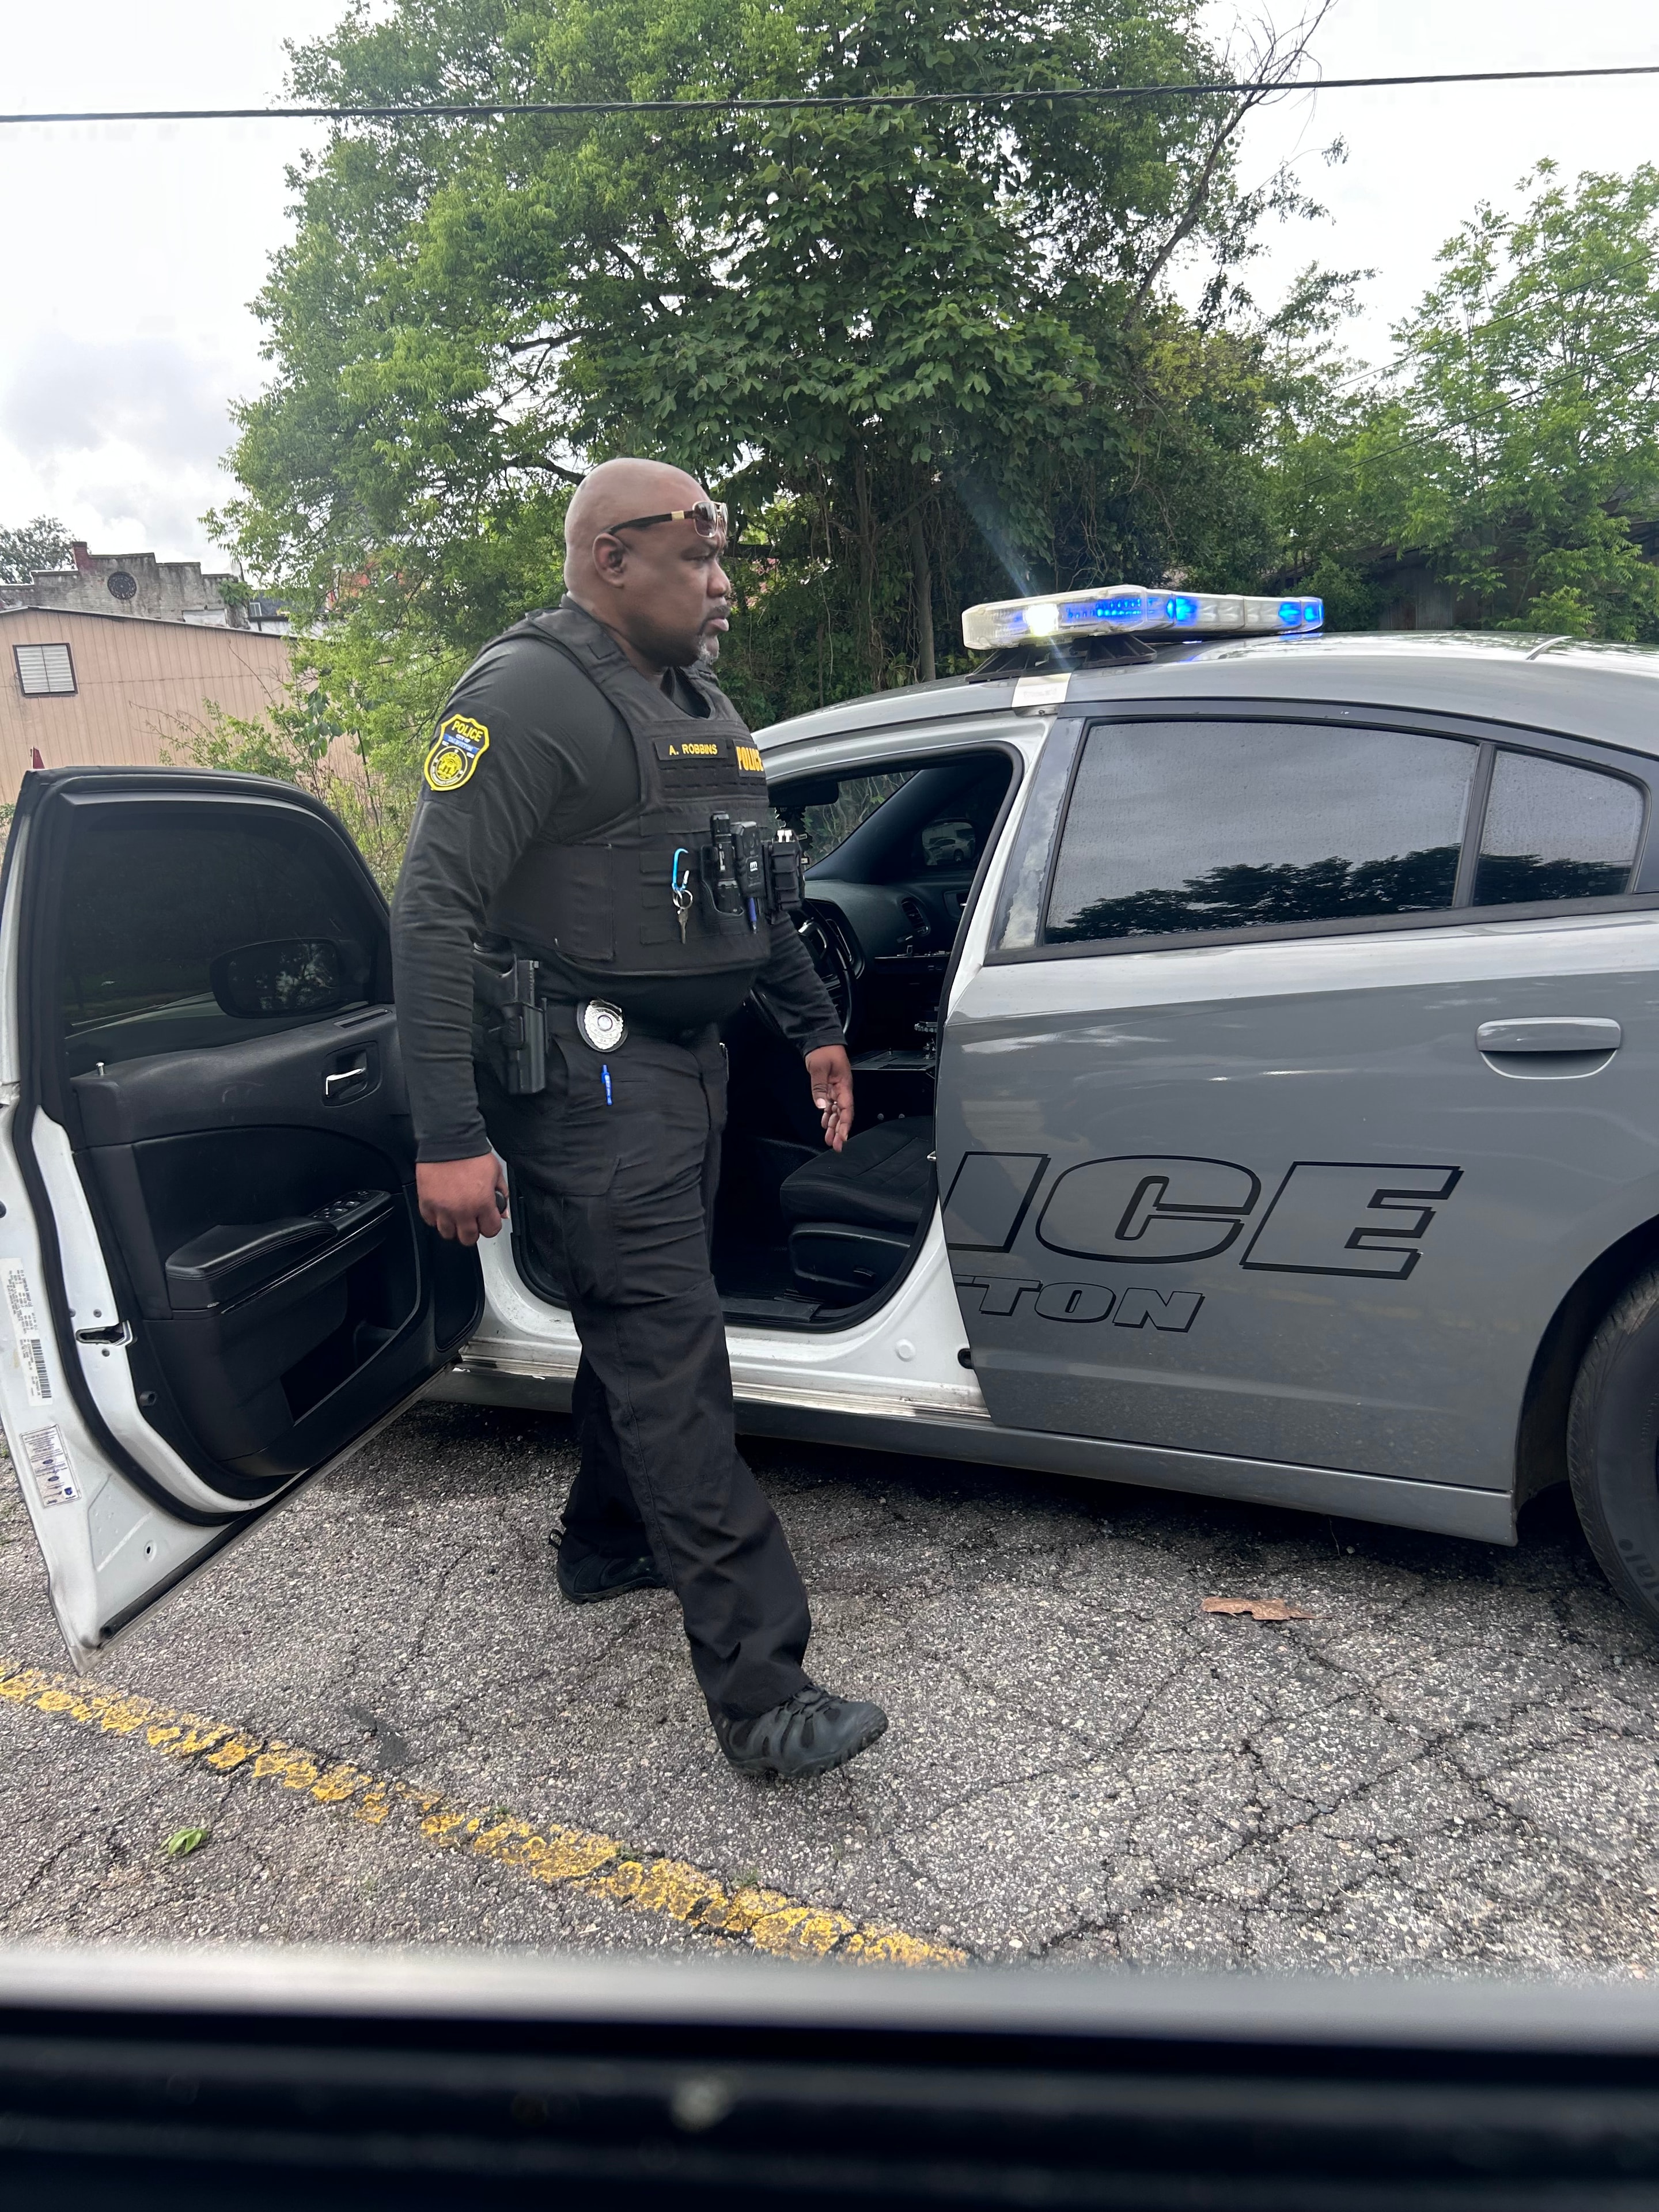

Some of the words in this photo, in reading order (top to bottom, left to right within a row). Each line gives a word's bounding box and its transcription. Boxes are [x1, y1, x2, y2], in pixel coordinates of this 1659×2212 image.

[452, 721, 483, 742] POLICE
[669, 745, 679, 756] A.
[681, 743, 718, 755] ROBBINS
[736, 747, 764, 771] POLICE
[942, 1150, 1464, 1280] ICE
[954, 1274, 1205, 1332] TON
